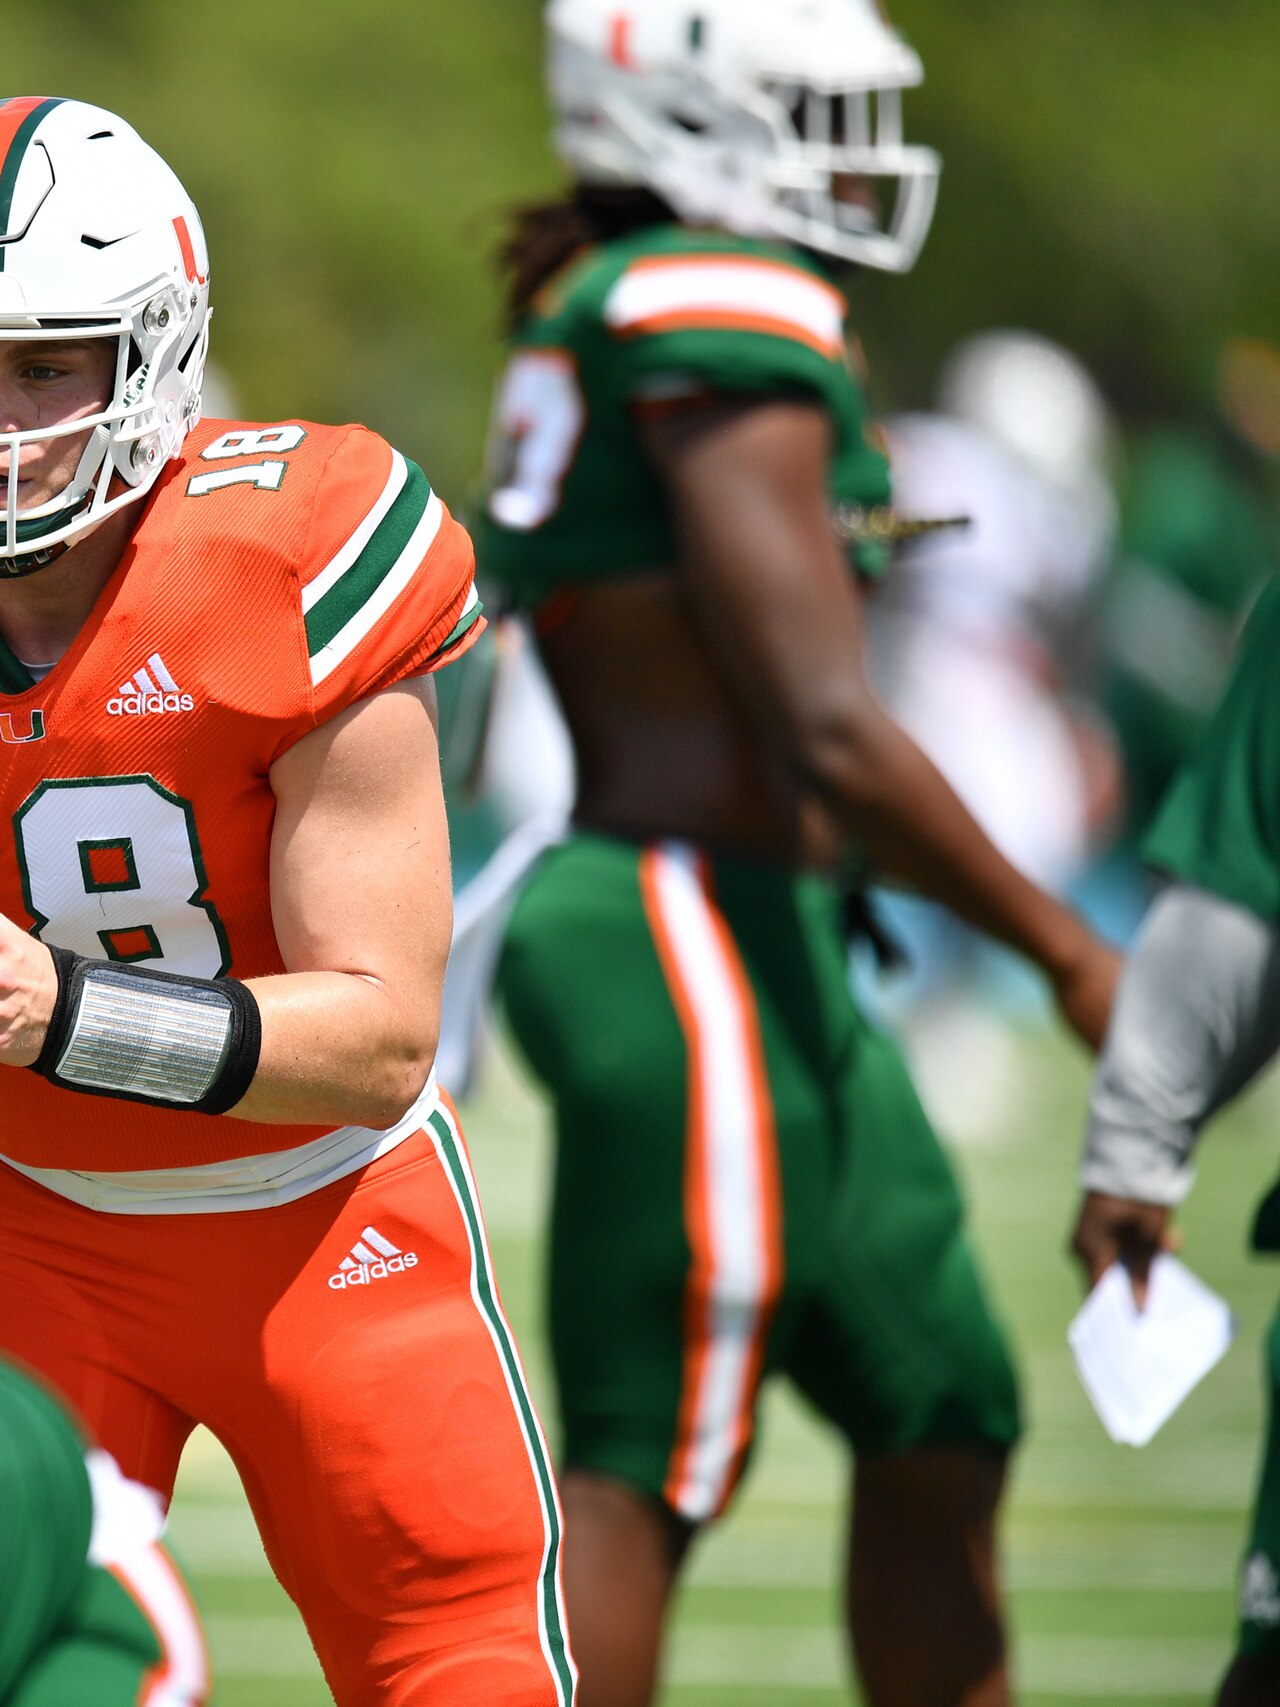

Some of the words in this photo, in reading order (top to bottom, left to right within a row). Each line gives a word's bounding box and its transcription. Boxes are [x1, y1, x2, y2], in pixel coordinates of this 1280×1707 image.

[184, 425, 308, 497] 18
[106, 692, 194, 716] adidas
[327, 1252, 419, 1290] adidas
